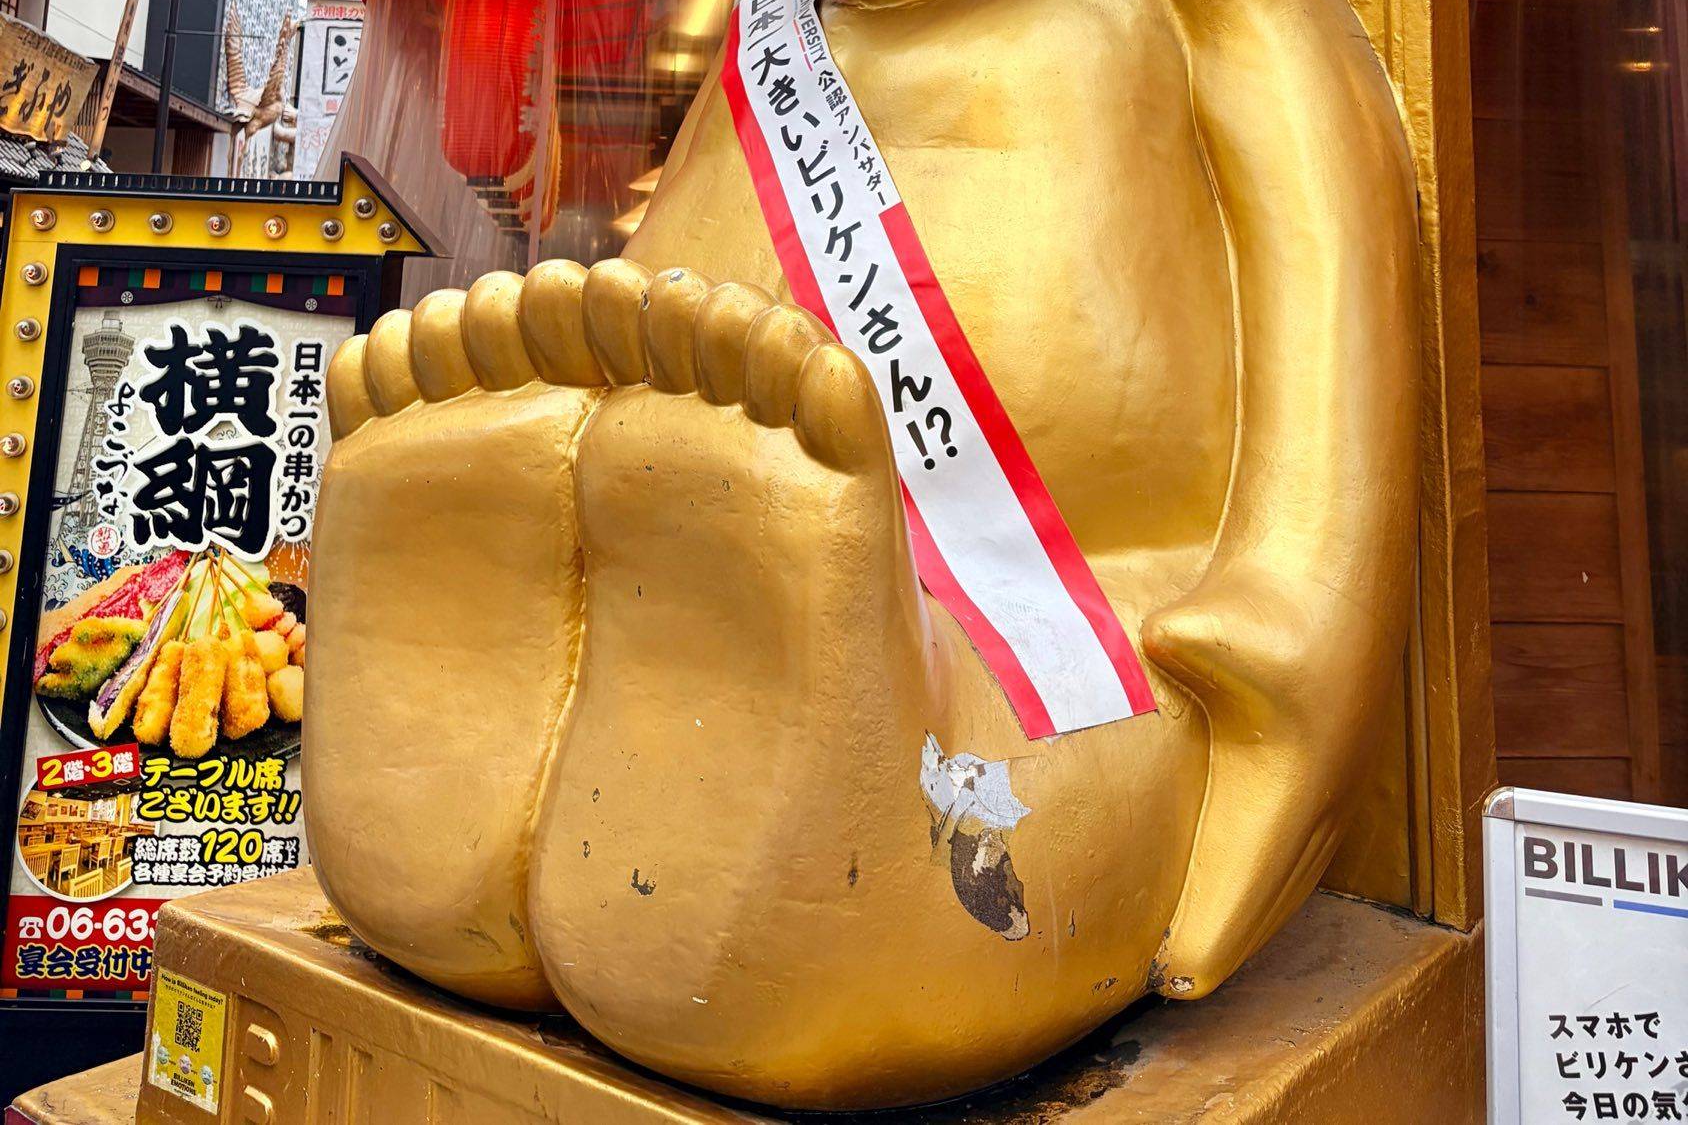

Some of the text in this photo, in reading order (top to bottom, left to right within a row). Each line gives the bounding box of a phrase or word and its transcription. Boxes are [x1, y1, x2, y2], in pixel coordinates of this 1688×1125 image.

[818, 70, 886, 206] 公認アンバサダー
[96, 382, 135, 515] よこづな
[131, 325, 279, 556] 横綱
[281, 343, 323, 536] 日本一の串かつ
[144, 755, 285, 789] テーブル席
[47, 906, 158, 941] 06-63
[1549, 1011, 1660, 1040] スマホで
[1562, 1090, 1688, 1121] 今日の気
